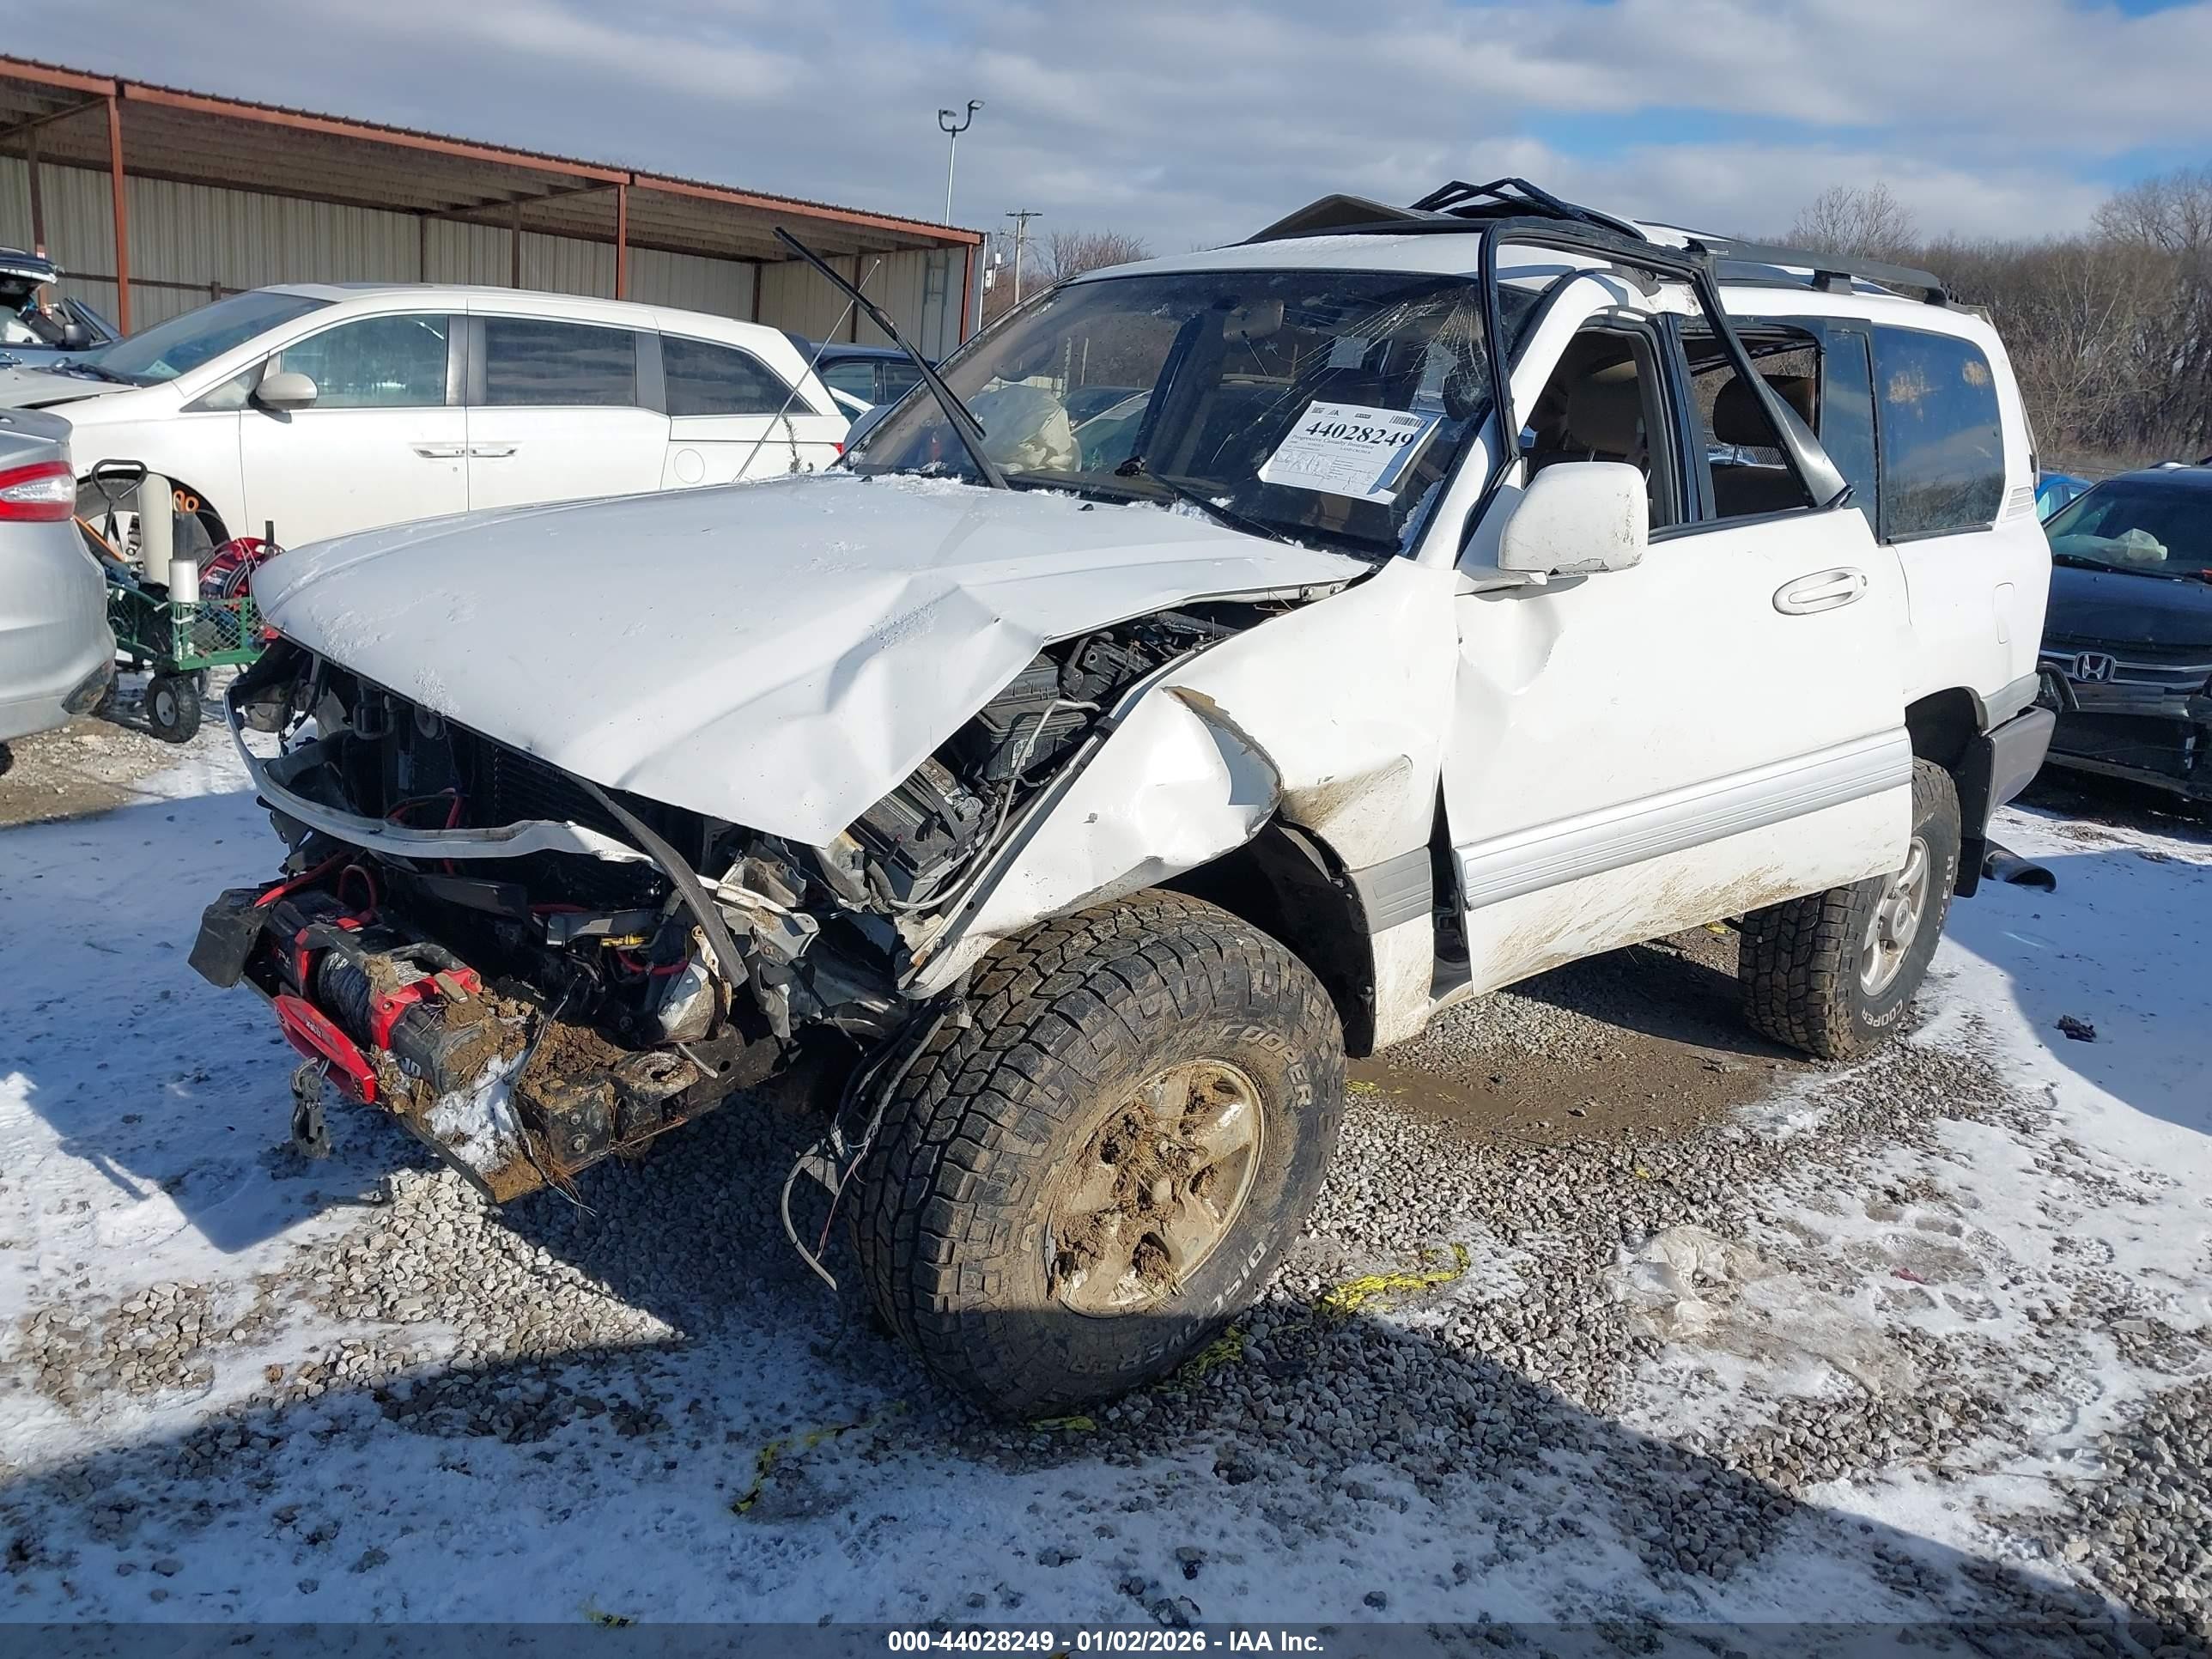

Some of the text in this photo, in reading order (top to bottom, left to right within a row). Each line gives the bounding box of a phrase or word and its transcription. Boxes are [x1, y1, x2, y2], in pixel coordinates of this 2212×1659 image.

[1305, 421, 1415, 448] 44028249
[1347, 441, 1375, 450] Insurance
[1862, 999, 1903, 1028] COOPER
[1217, 1022, 1314, 1109] COOPER
